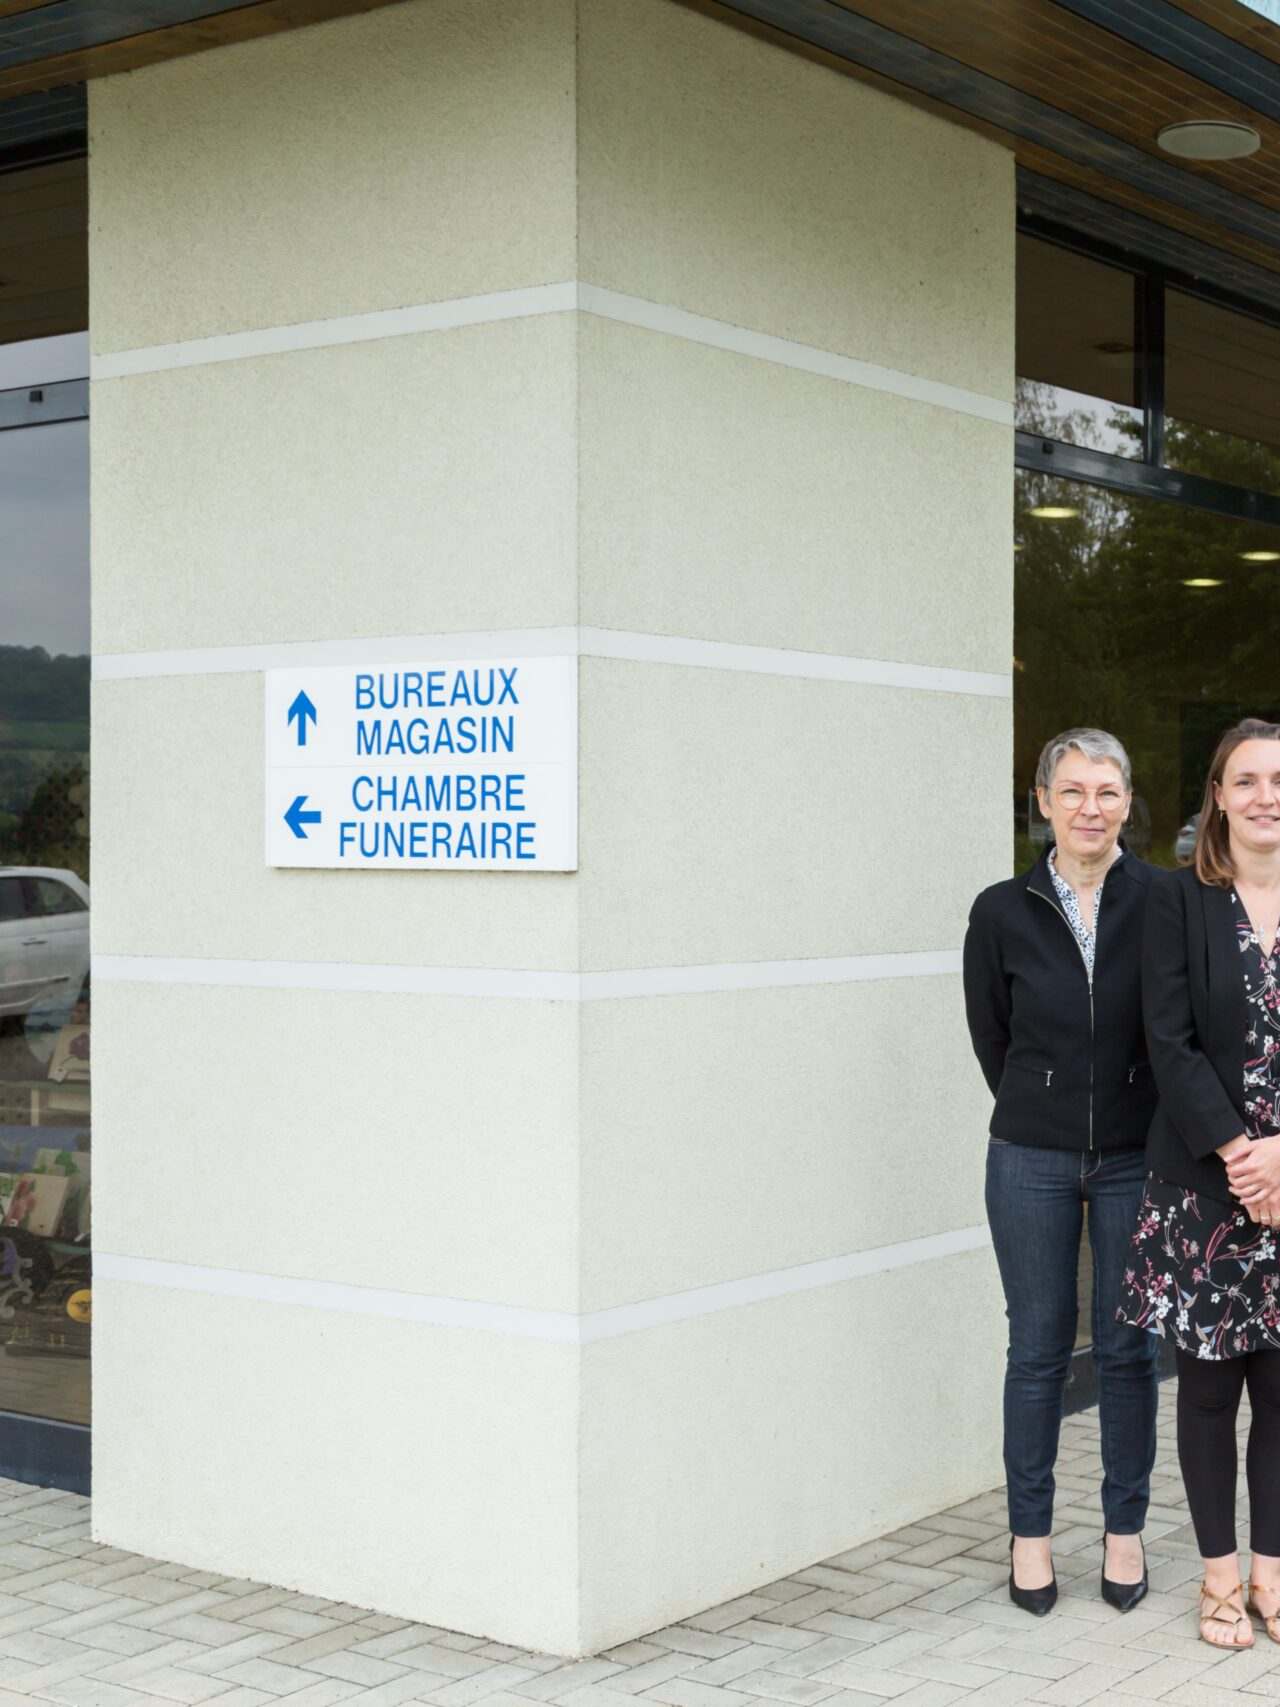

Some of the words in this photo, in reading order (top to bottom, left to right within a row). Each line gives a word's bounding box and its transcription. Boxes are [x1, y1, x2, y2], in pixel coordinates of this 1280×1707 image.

[355, 668, 519, 710] BUREAUX
[356, 715, 514, 755] MAGASIN
[352, 774, 526, 812] CHAMBRE
[339, 822, 536, 859] FUNERAIRE
